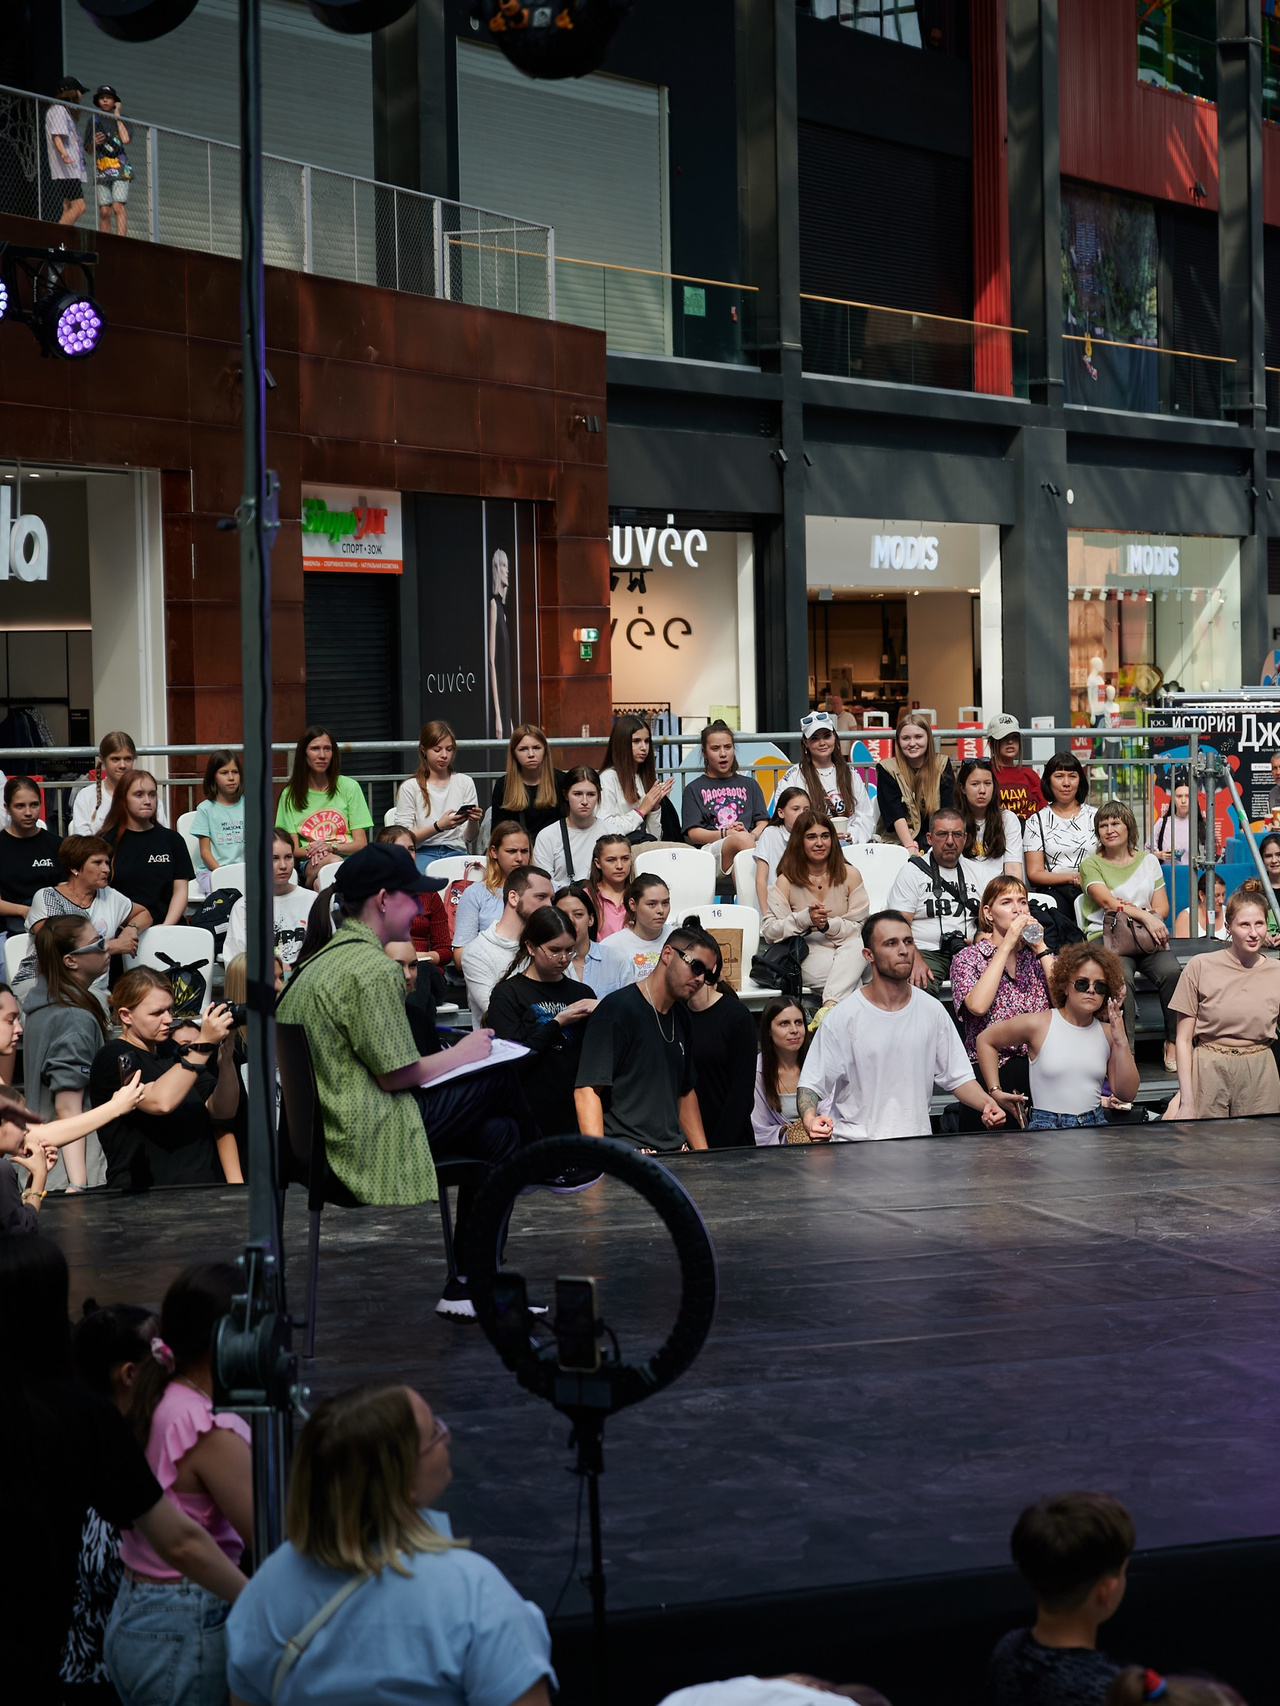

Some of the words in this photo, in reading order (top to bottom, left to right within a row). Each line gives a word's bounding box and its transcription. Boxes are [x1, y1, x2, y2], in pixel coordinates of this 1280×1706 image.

[341, 542, 363, 554] СПОРТ
[367, 544, 383, 555] ЗОЖ
[612, 513, 708, 568] uvée
[870, 534, 939, 571] MODIS
[1126, 544, 1180, 576] MODIS
[1172, 714, 1236, 734] ИСТОРИЯ
[700, 787, 748, 806] DANGEROUS
[301, 811, 344, 835] VINTAGE
[147, 854, 171, 864] AGR
[671, 853, 677, 861] 8
[711, 910, 723, 918] 16
